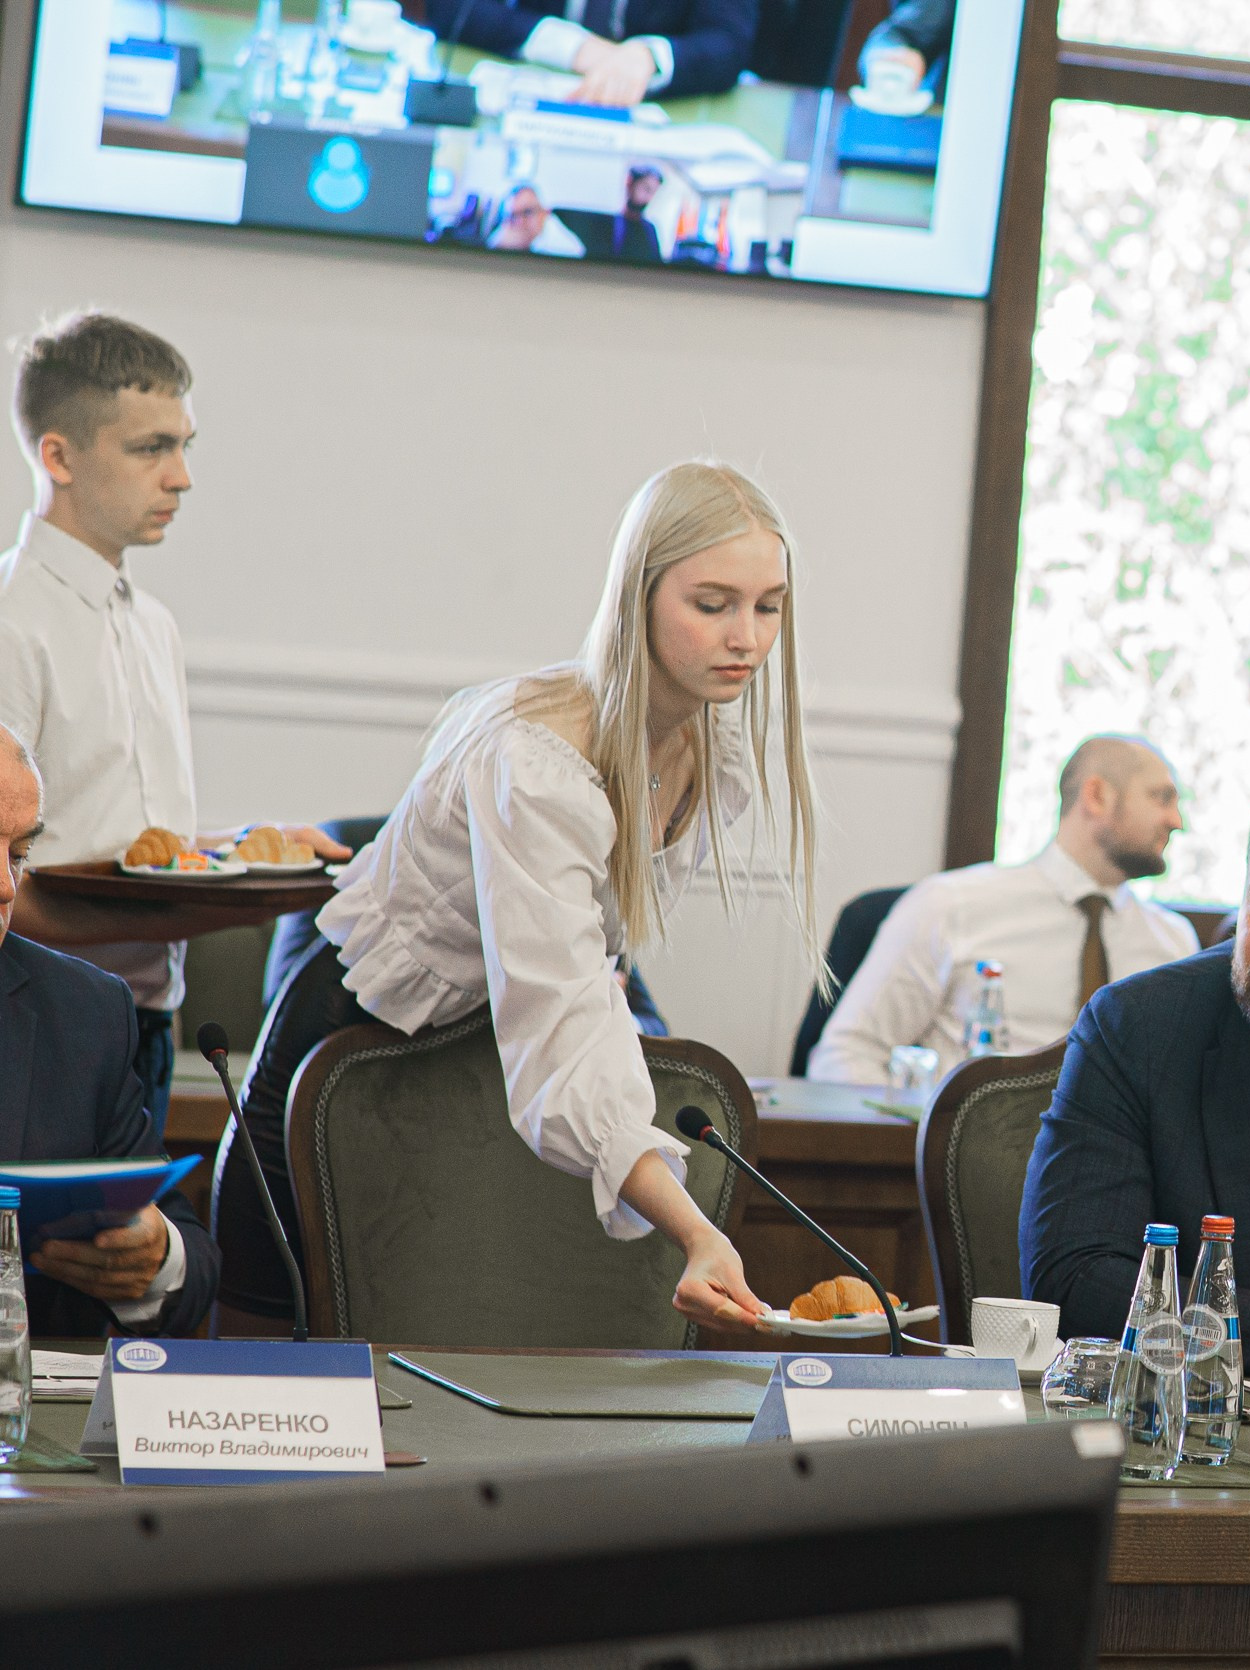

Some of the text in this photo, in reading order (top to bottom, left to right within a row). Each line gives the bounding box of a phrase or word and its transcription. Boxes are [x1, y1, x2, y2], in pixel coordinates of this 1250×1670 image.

[167, 1410, 329, 1434] НАЗАРЕНКО
[134, 1437, 368, 1461] Виктор Владимирович
